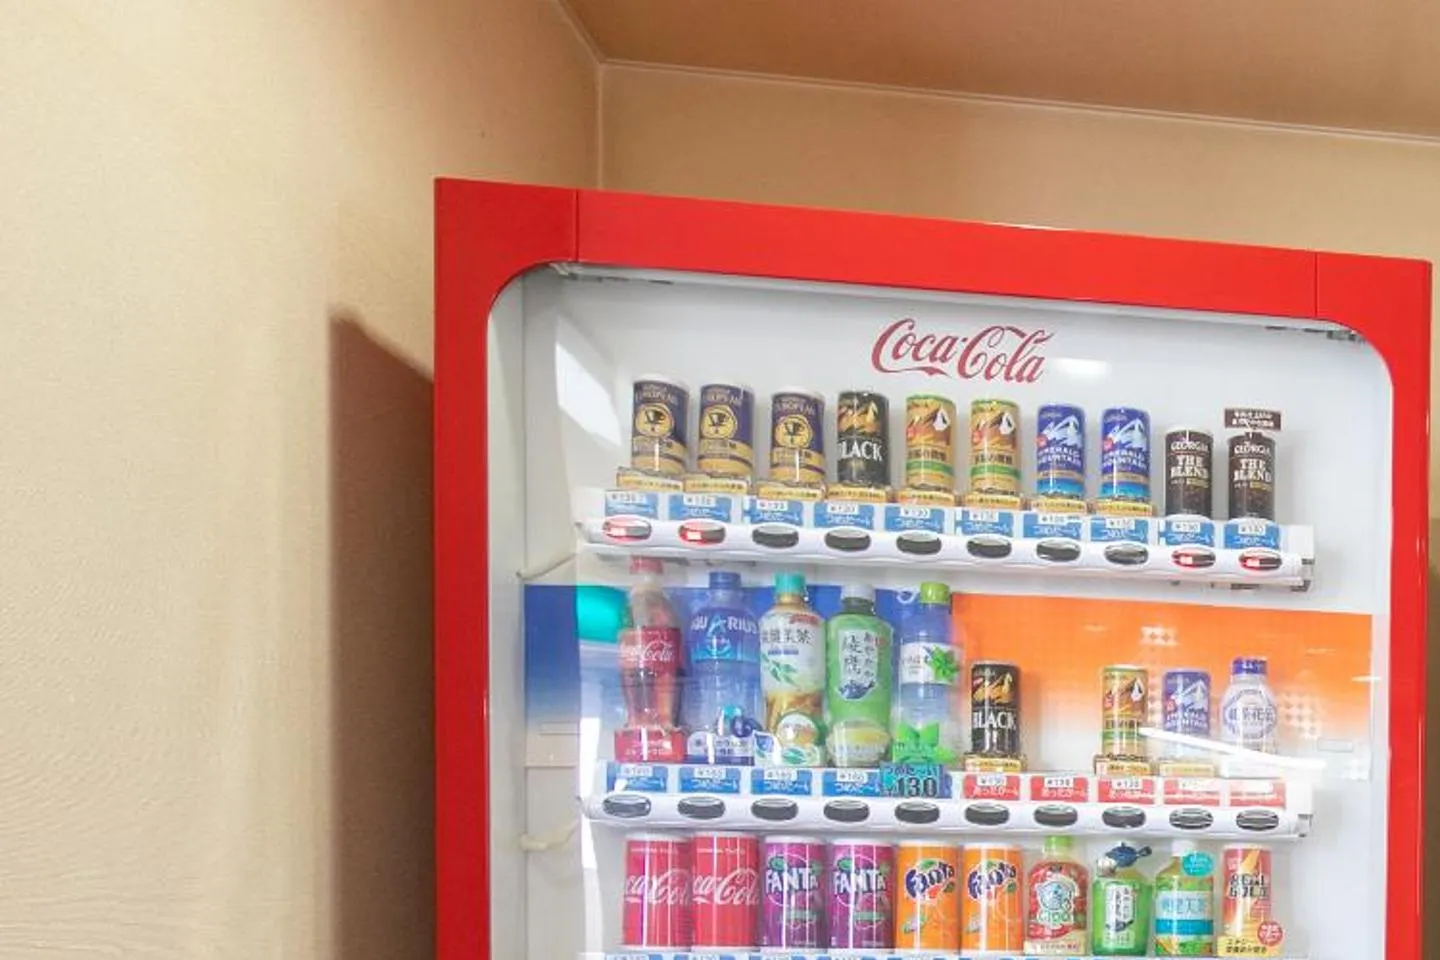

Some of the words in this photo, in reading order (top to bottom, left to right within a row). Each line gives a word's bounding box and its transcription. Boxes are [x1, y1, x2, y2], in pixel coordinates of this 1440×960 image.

[871, 318, 1055, 384] Coca-Cola
[1177, 454, 1204, 467] THE
[1240, 458, 1266, 470] THE
[765, 864, 818, 893] FANTA
[833, 869, 886, 895] FANTA
